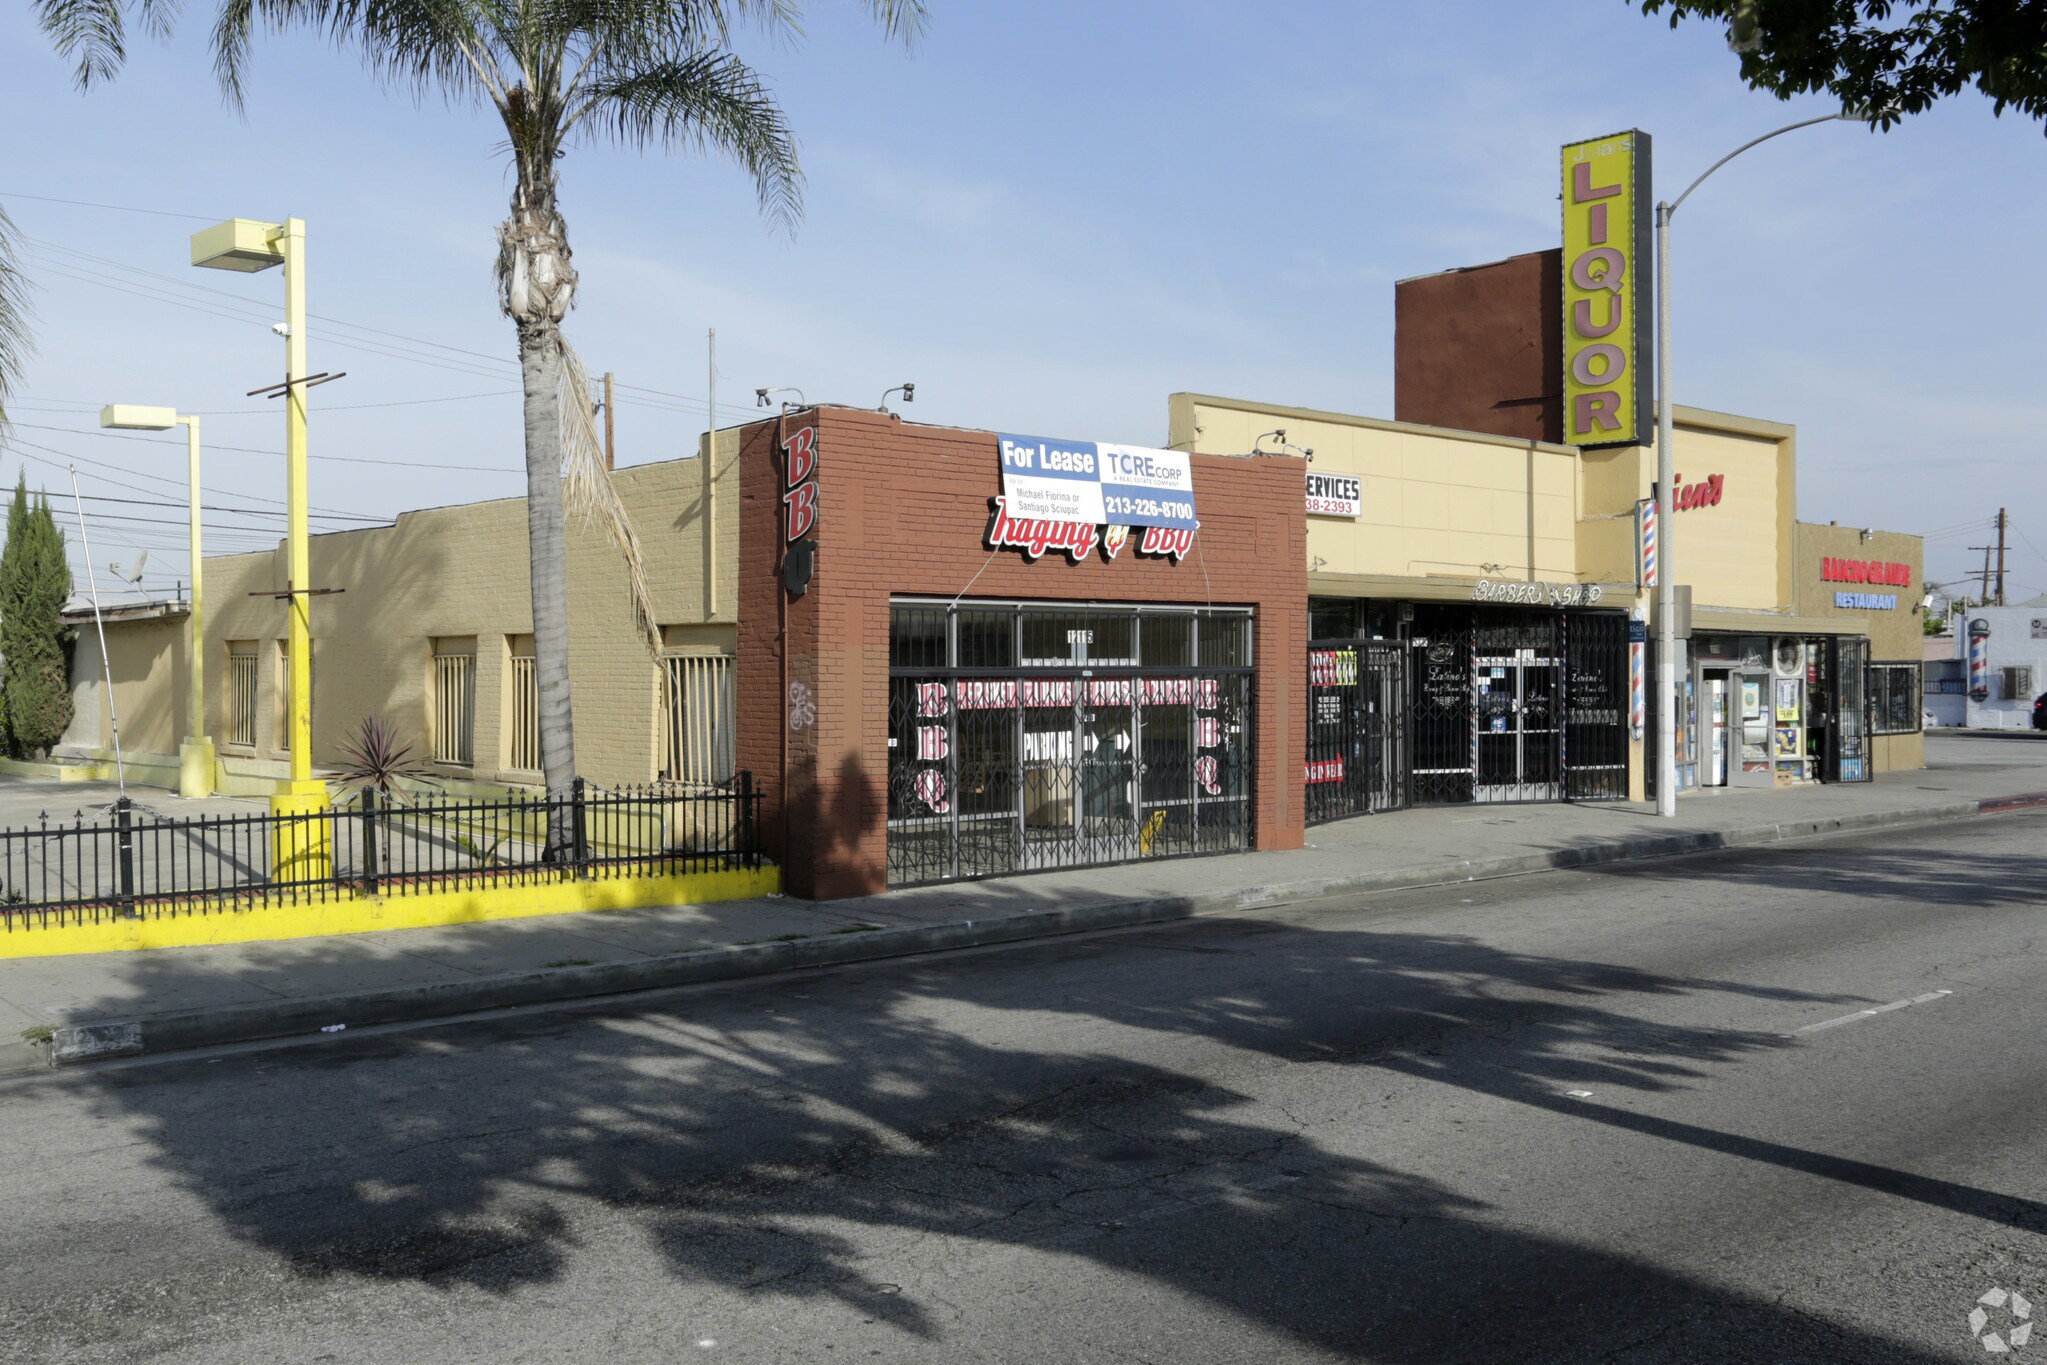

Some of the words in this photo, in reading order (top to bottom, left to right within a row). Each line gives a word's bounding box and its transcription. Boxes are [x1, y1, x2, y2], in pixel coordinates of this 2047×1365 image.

[1573, 161, 1626, 434] LIQUOR
[1002, 440, 1035, 469] For
[1040, 444, 1094, 474] Lease
[1016, 487, 1044, 500] Michael
[1045, 490, 1071, 502] Fiorina
[1072, 494, 1080, 502] or
[1018, 499, 1050, 514] Santiago
[1051, 503, 1079, 515] Sciupac
[1105, 496, 1193, 520] 213-226-8700
[1821, 556, 1867, 584] RANCHO
[1867, 560, 1911, 588] GRANDE
[1474, 579, 1542, 605] BARBER
[1562, 586, 1602, 606] SHOP
[1834, 591, 1897, 610] RESTAURANT
